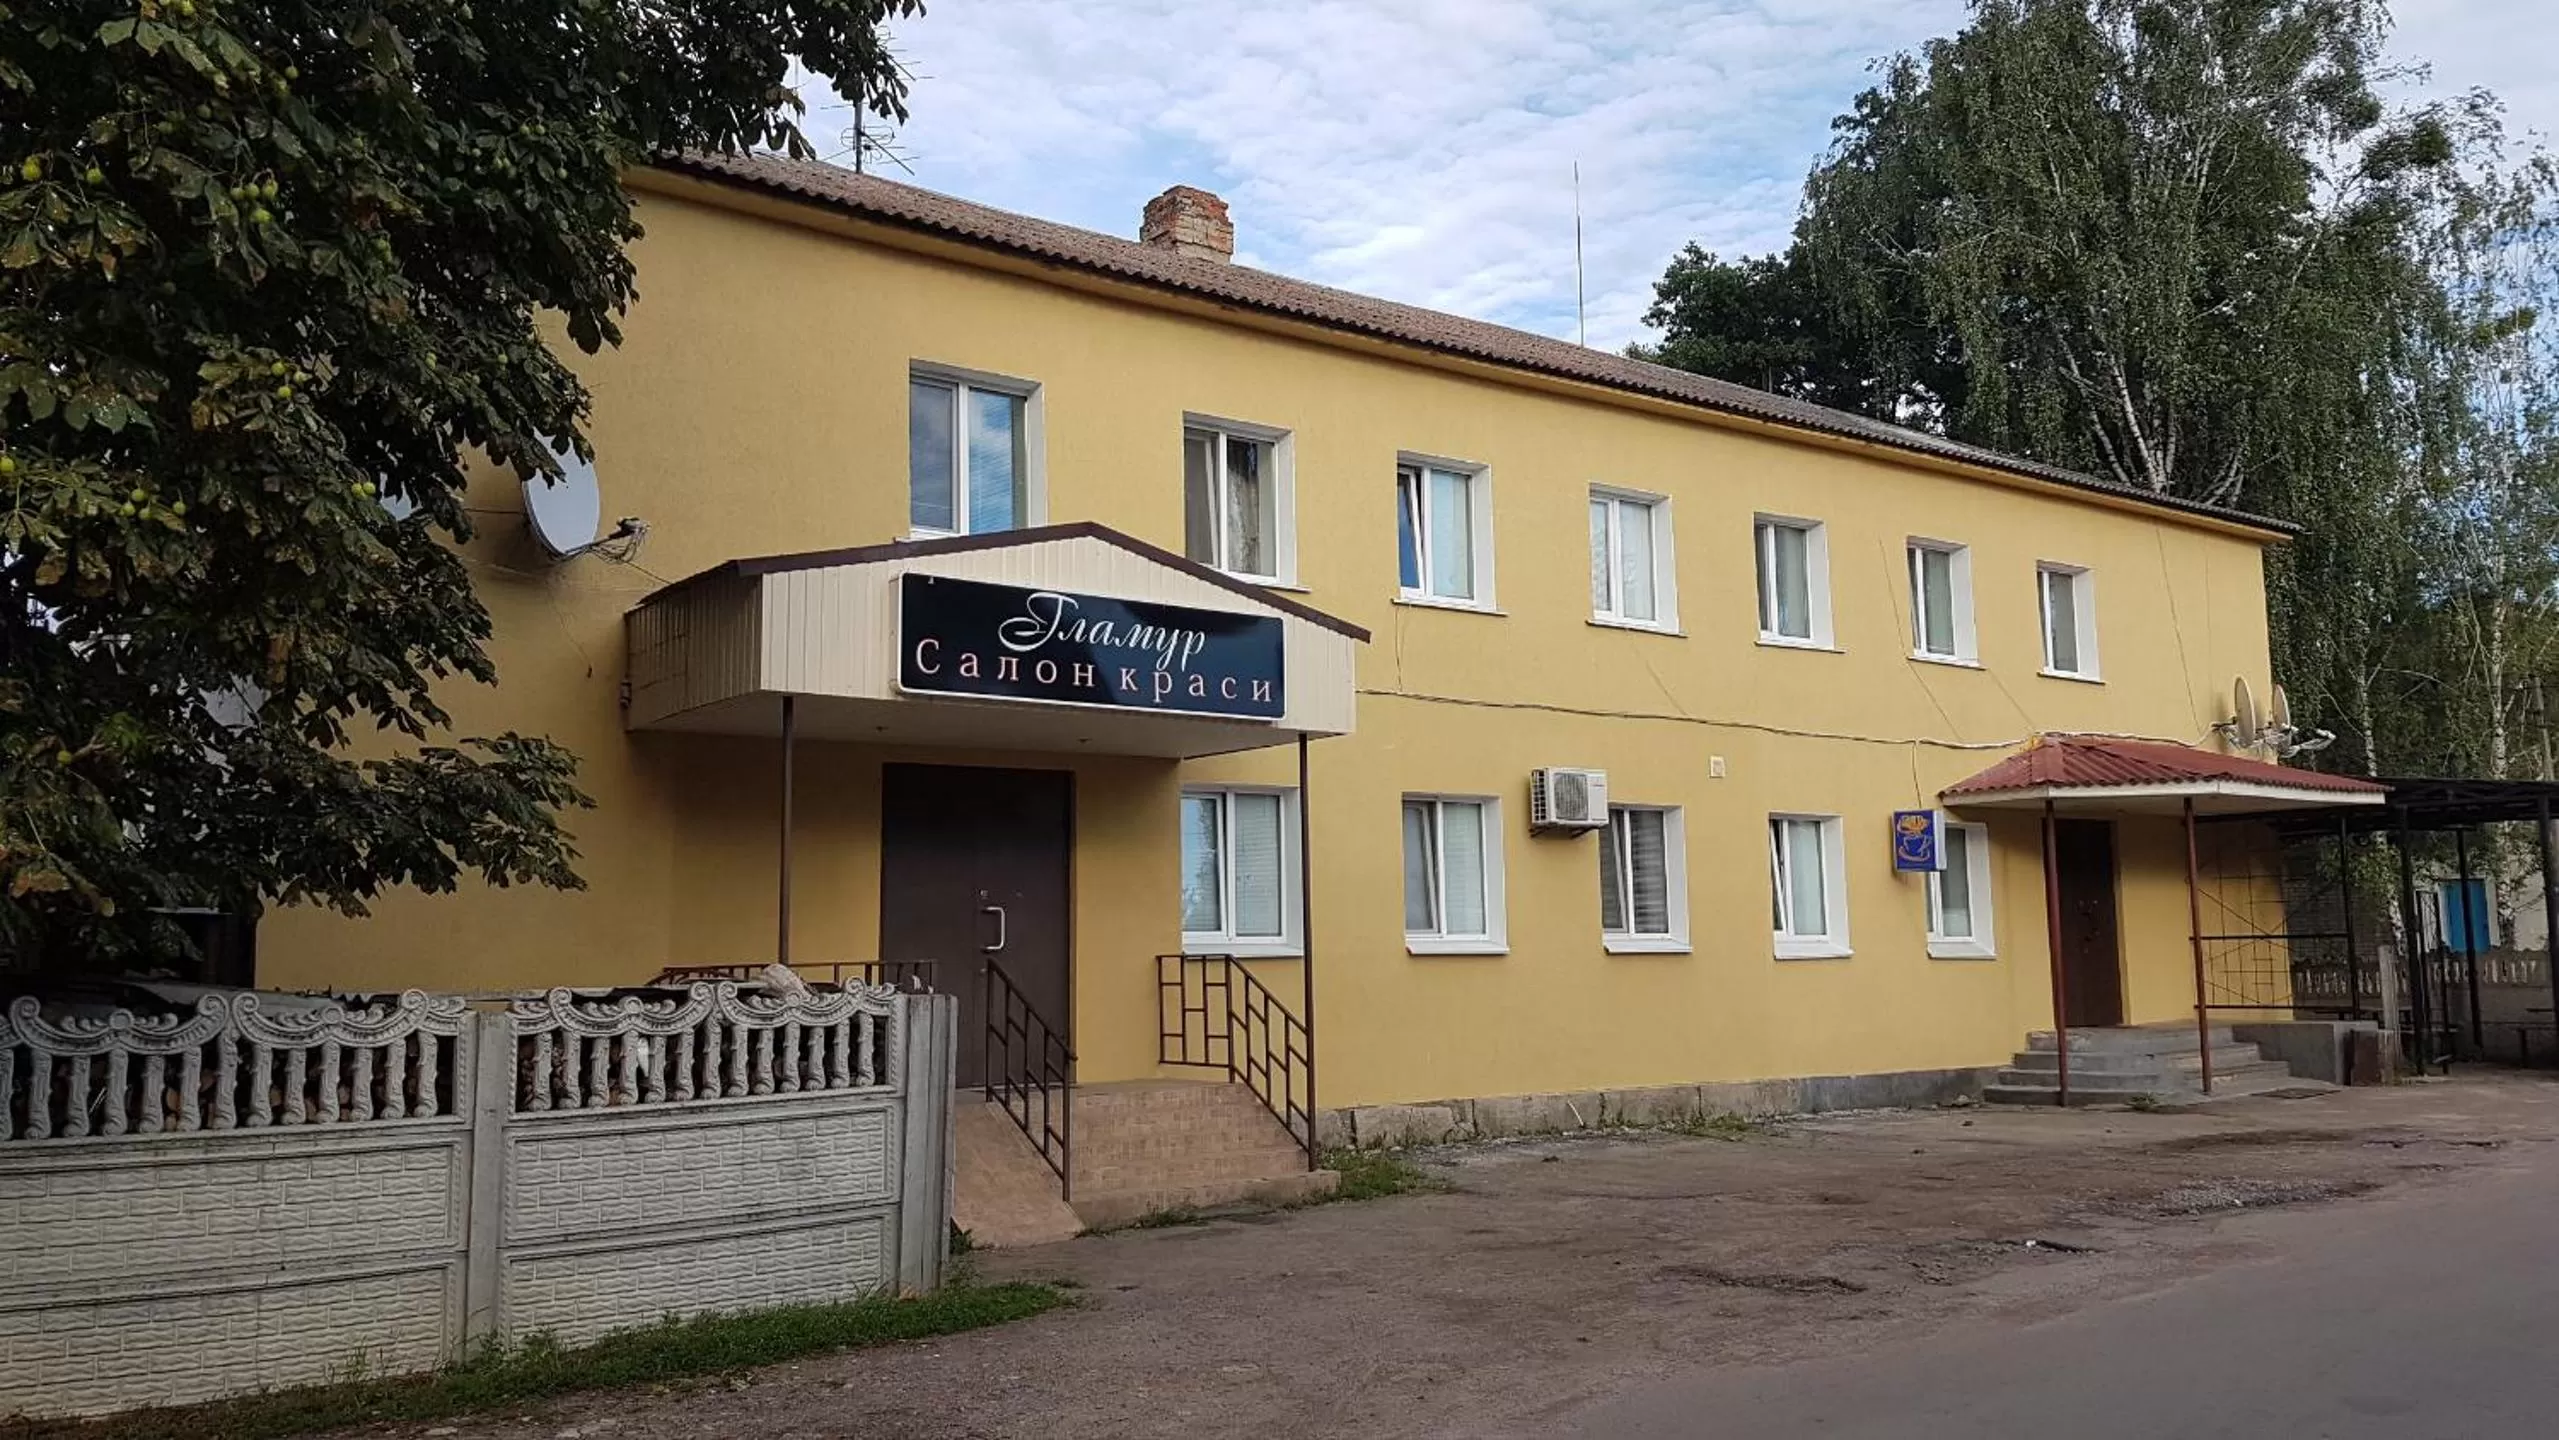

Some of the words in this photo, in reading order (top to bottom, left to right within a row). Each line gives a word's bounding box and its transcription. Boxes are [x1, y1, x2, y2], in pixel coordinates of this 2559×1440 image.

[998, 591, 1205, 672] Гламур
[916, 638, 1095, 687] Салон
[1119, 666, 1272, 703] краси
